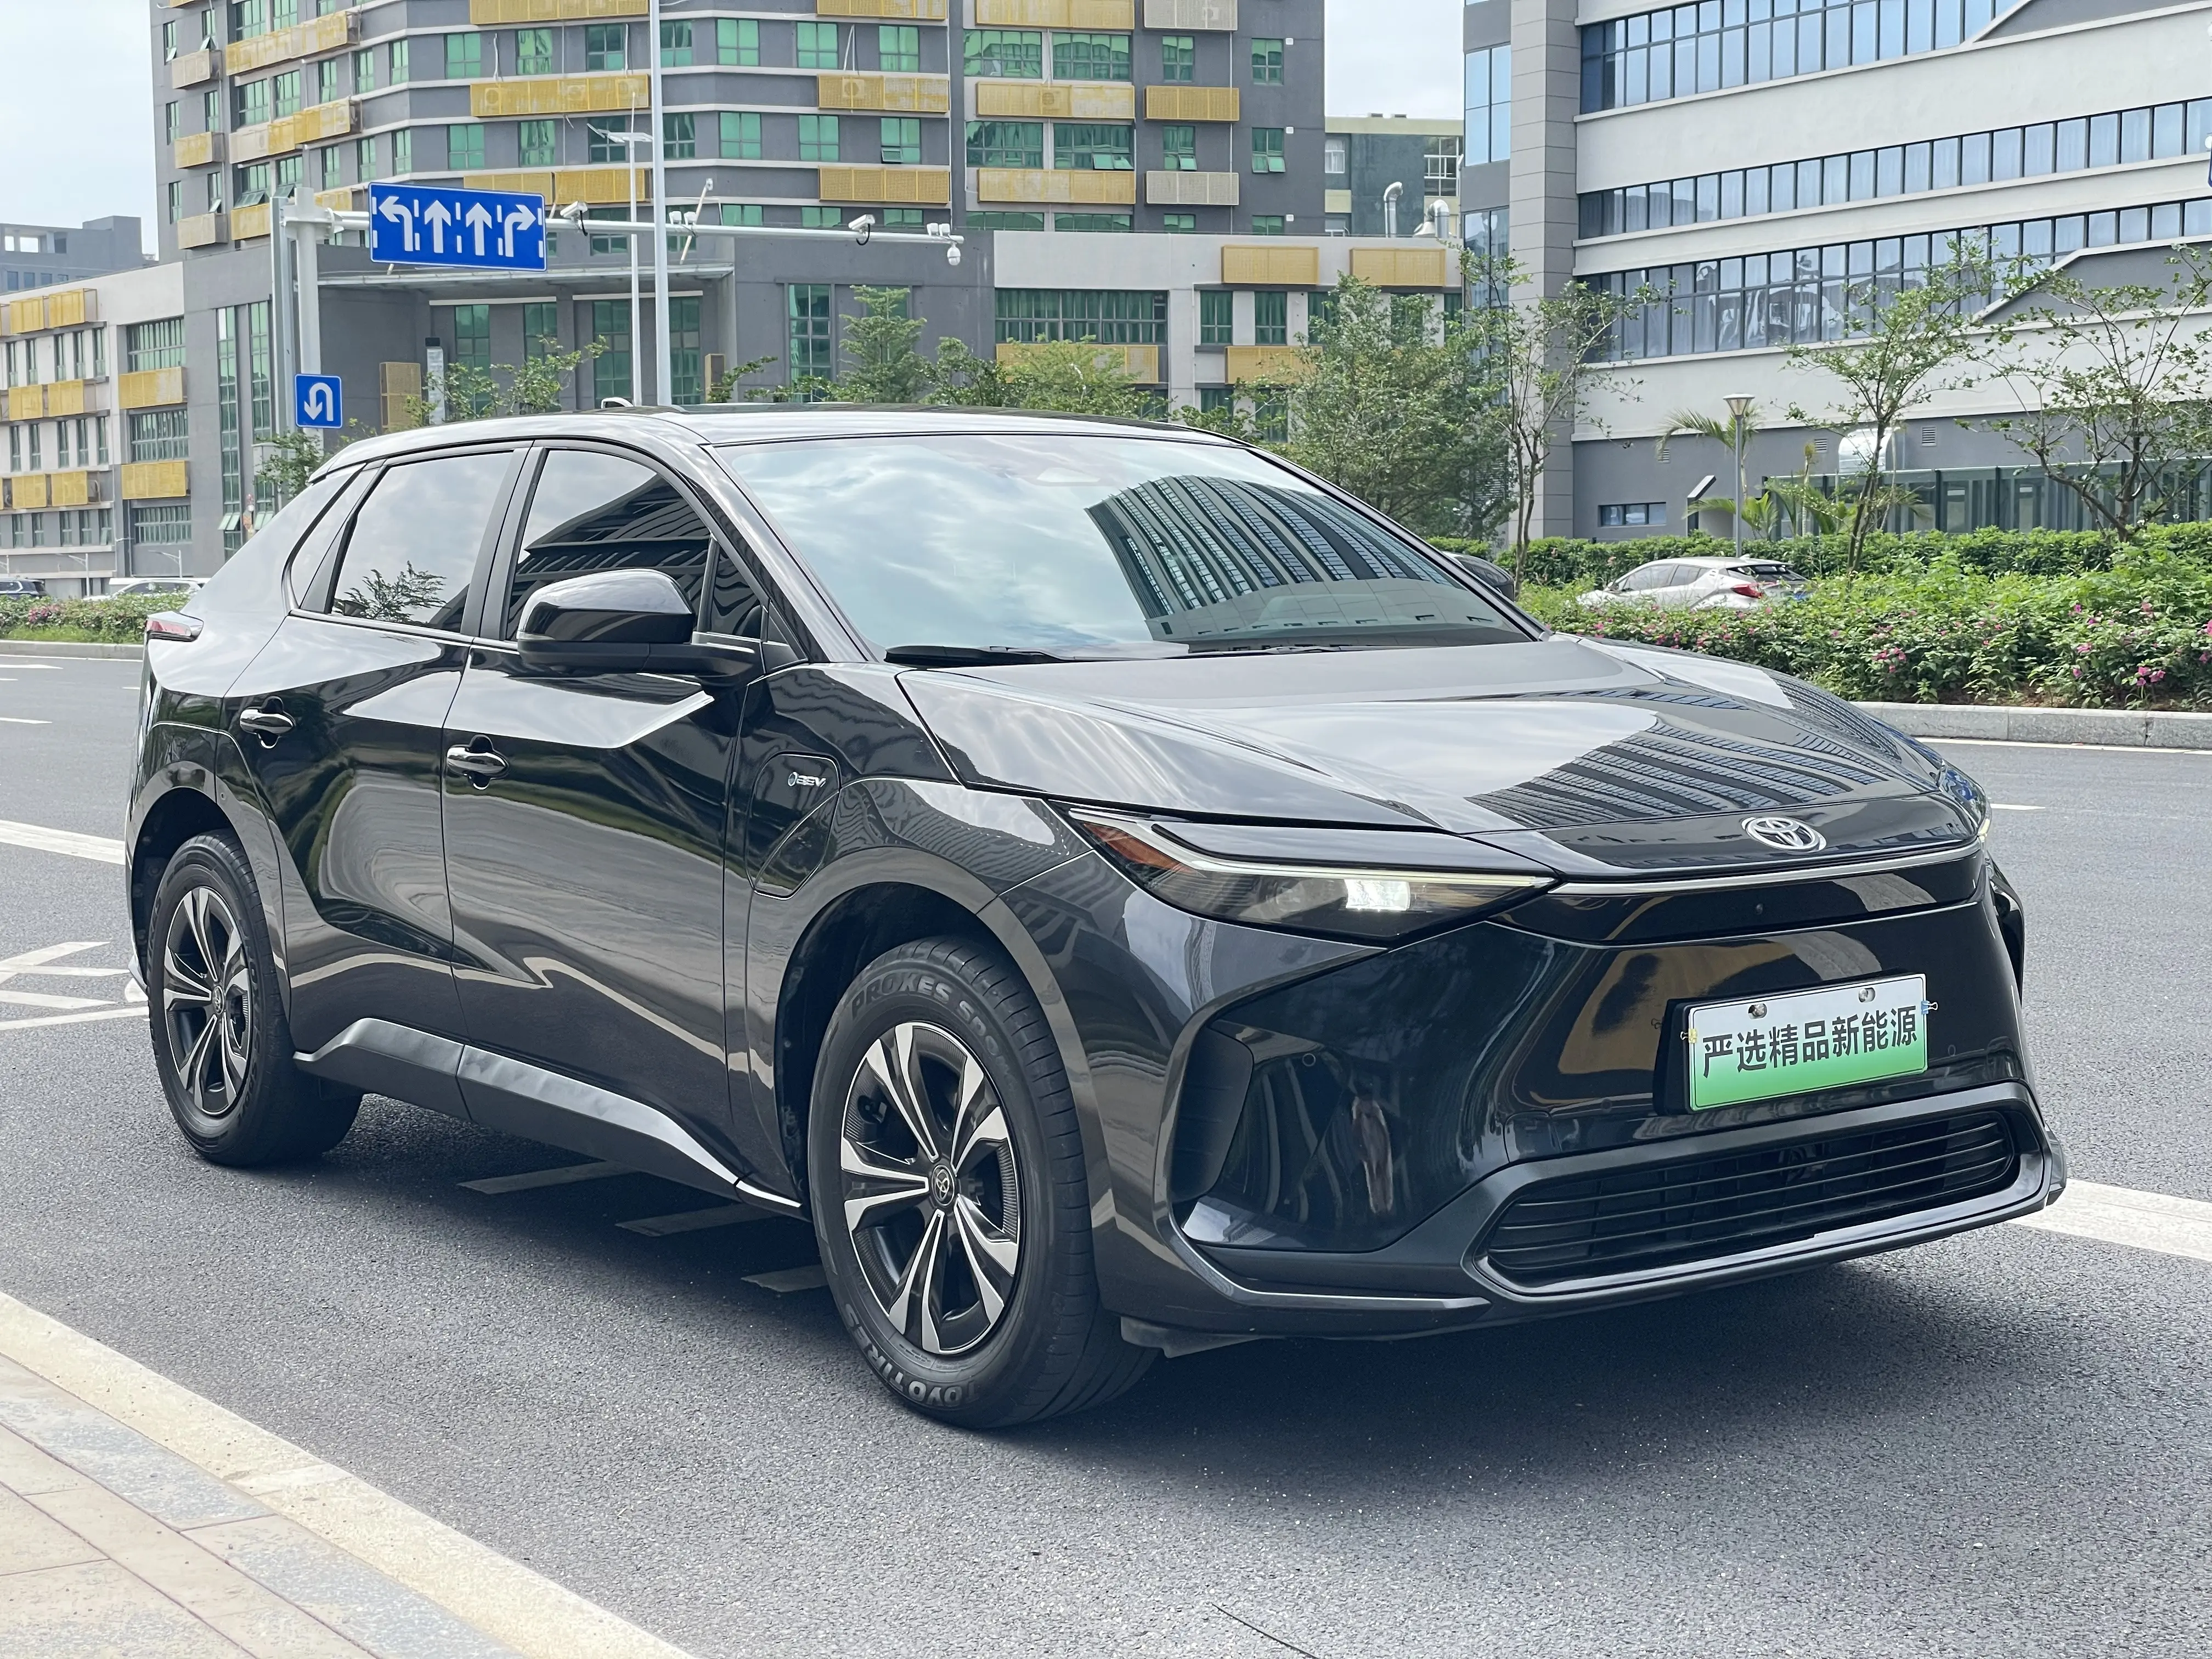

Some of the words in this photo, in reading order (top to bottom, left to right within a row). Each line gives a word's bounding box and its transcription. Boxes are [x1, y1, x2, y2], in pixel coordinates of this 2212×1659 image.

[796, 775, 827, 788] BEV
[1702, 1004, 1918, 1078] 严选精品新能源
[845, 1304, 905, 1392] TIRES
[909, 1380, 979, 1407] TOYO
